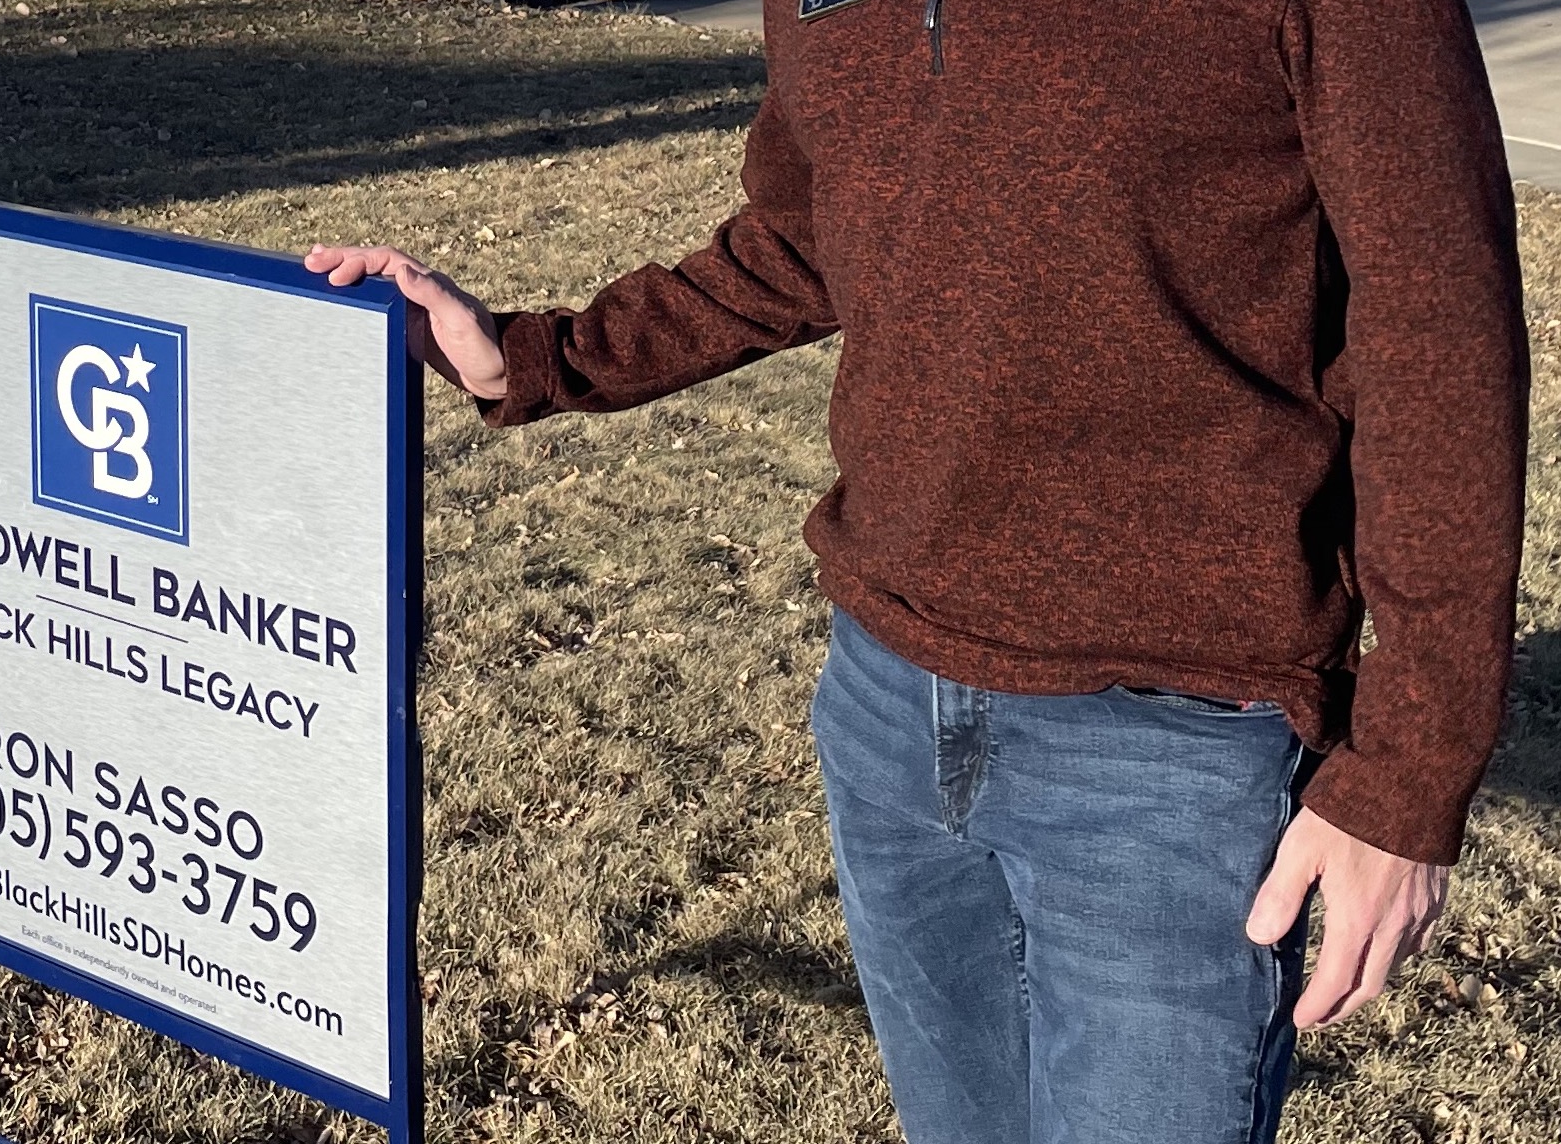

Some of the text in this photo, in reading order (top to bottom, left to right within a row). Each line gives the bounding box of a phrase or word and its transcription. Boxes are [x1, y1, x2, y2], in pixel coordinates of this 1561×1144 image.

[57, 344, 153, 499] CB
[153, 567, 358, 674] BANKER
[48, 618, 149, 685] HILLS
[161, 654, 320, 738] LEGACY
[95, 762, 264, 861] SASSO
[64, 809, 318, 953] 593-3759
[21, 924, 41, 940] Each
[42, 934, 63, 950] office
[65, 943, 72, 954] is
[73, 946, 129, 979] independently
[131, 972, 159, 990] owned
[160, 984, 177, 997] and
